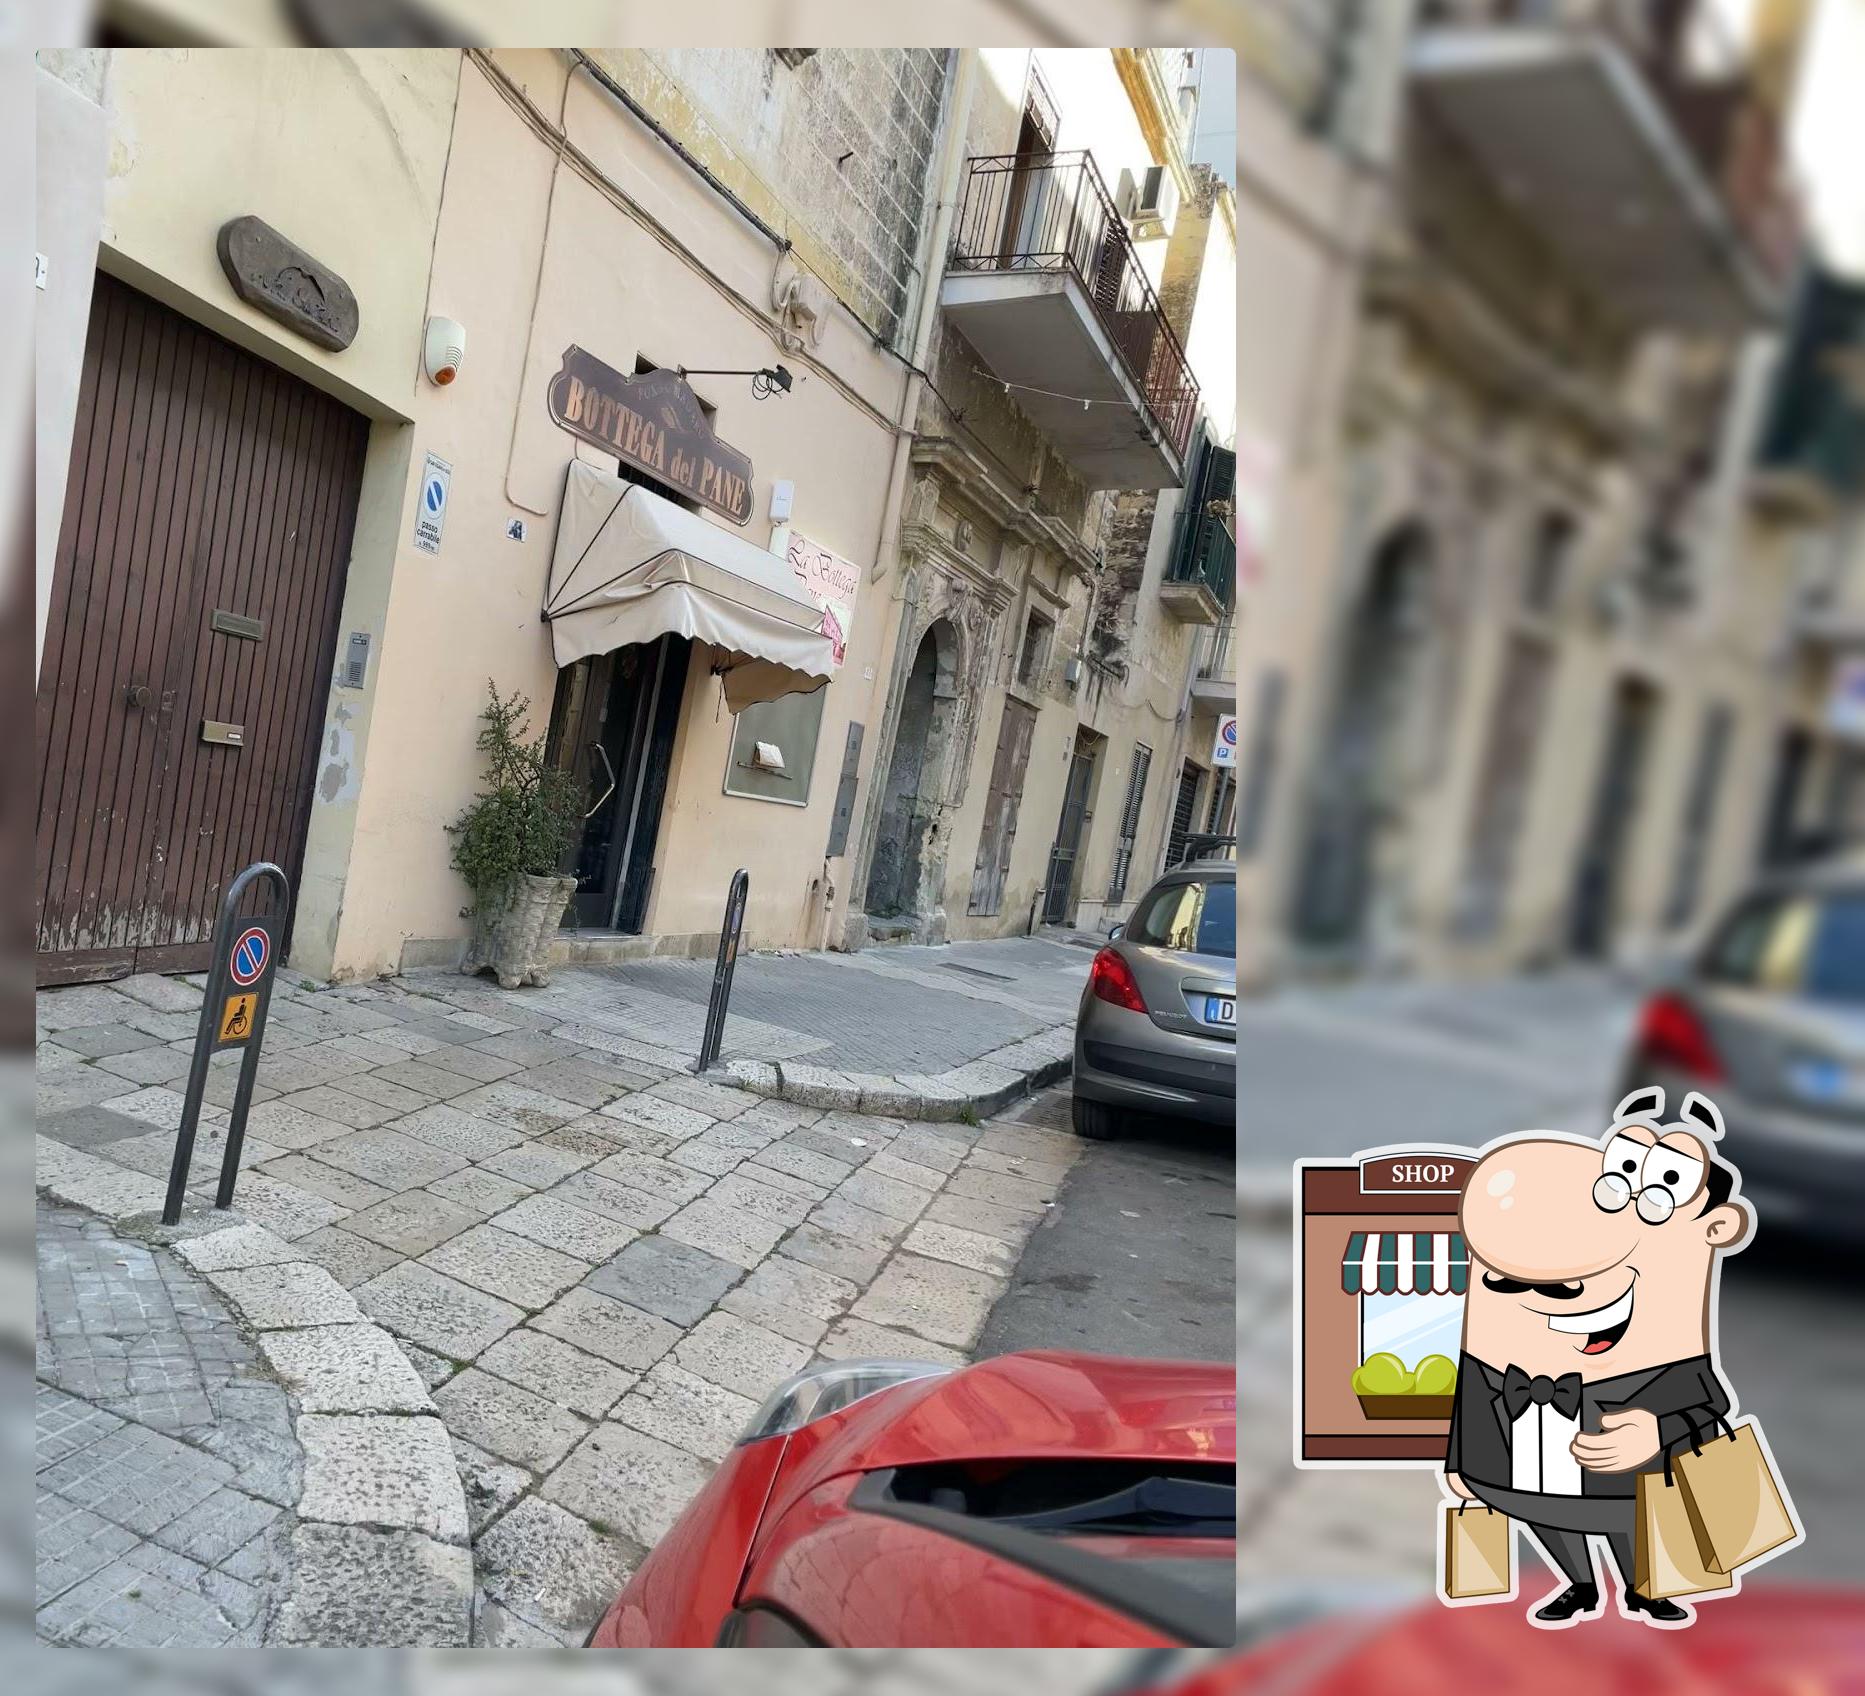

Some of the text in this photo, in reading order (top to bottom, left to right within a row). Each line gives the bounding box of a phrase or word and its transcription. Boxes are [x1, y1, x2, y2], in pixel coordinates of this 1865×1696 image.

[564, 376, 665, 472] BOTTEGA
[671, 447, 696, 489] del
[700, 456, 747, 515] PANE
[416, 529, 440, 545] carrabile
[421, 521, 438, 534] passo
[788, 540, 810, 569] La
